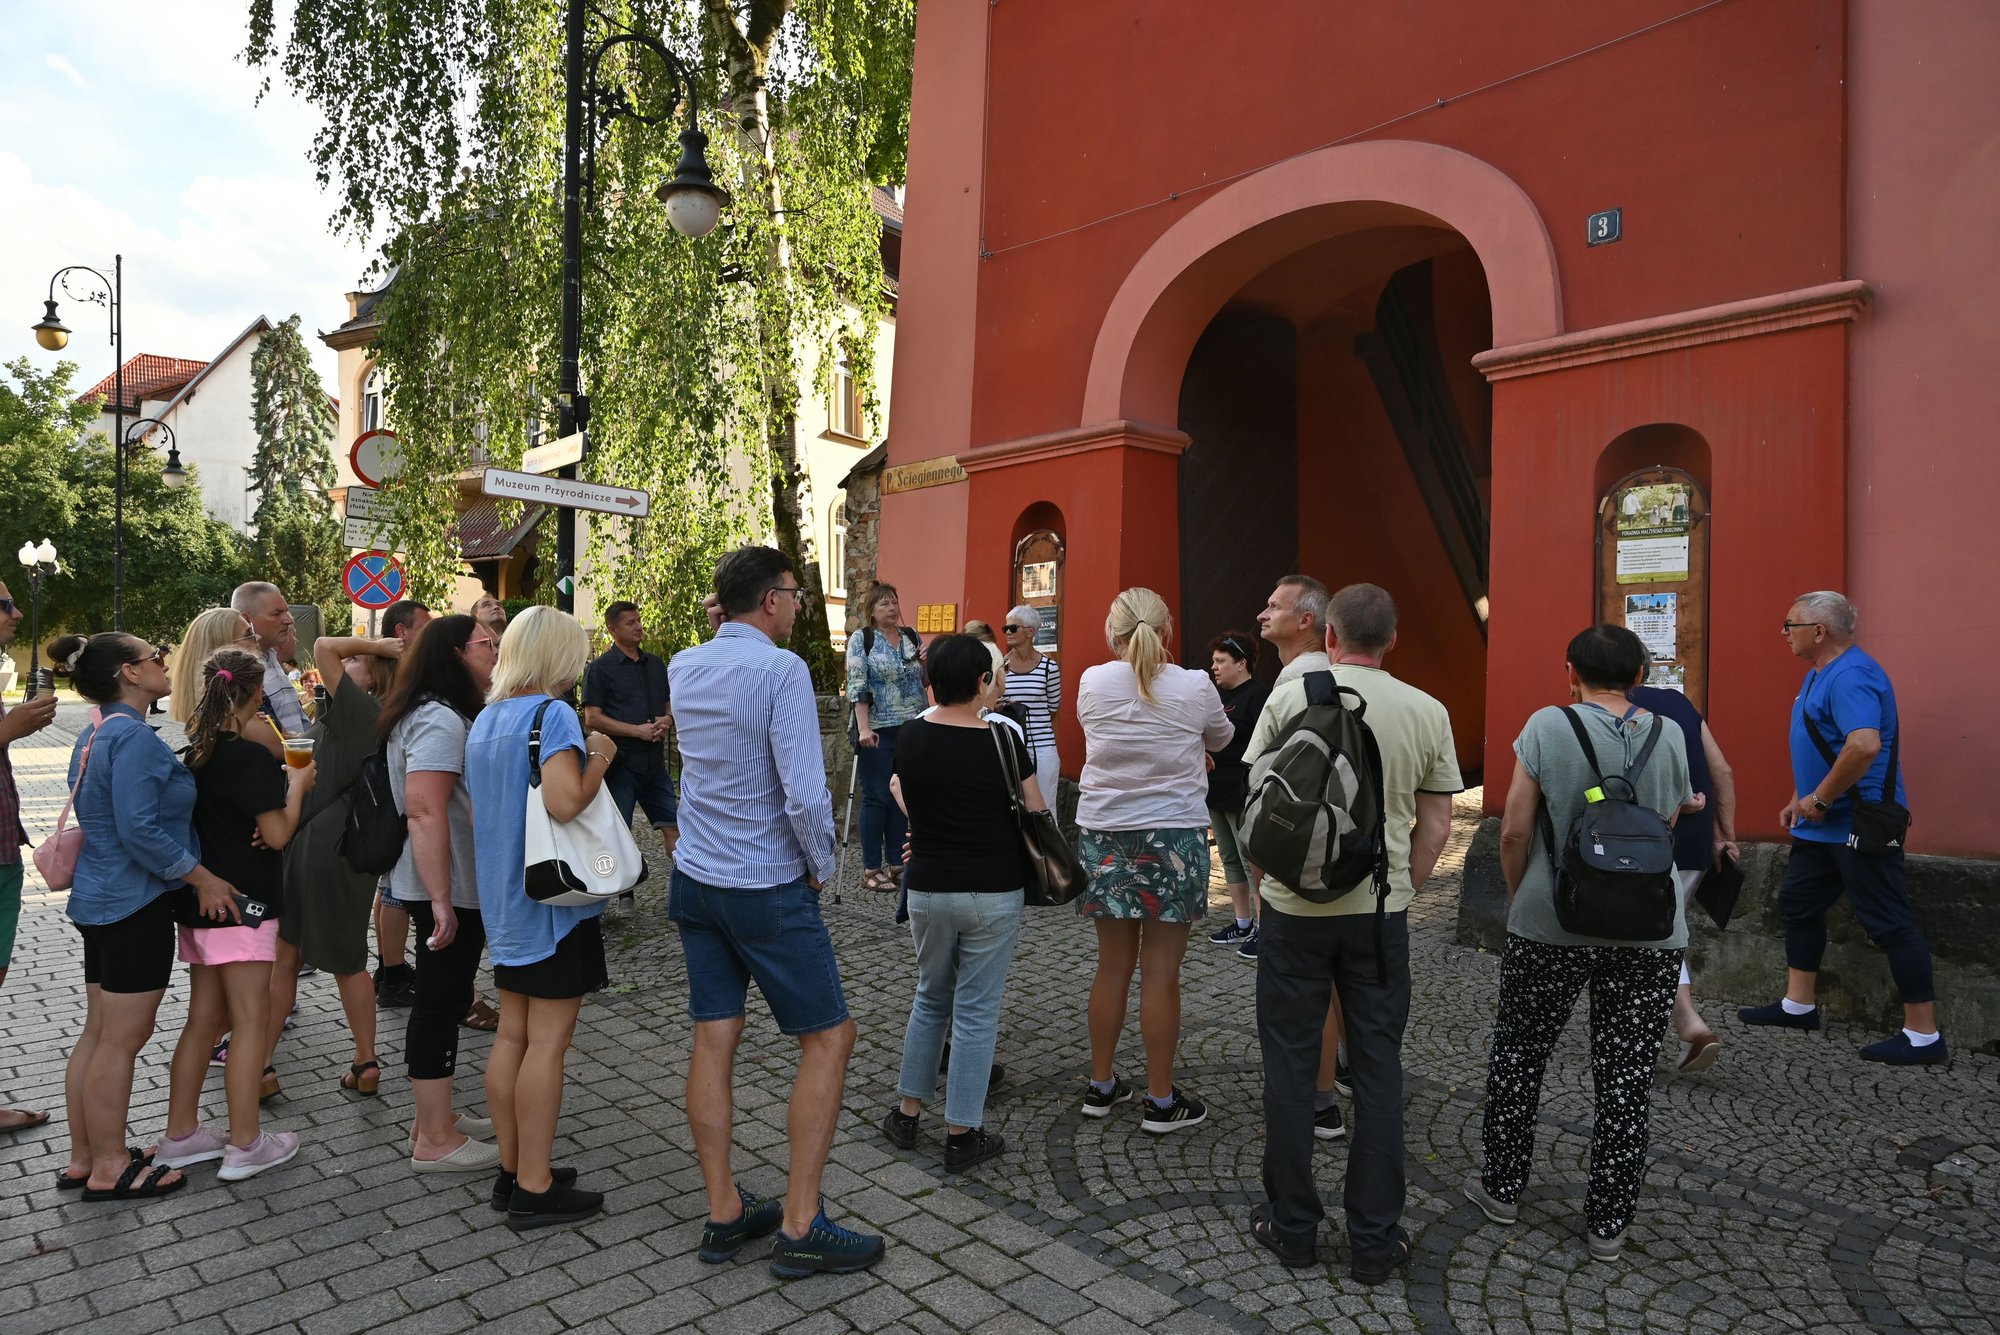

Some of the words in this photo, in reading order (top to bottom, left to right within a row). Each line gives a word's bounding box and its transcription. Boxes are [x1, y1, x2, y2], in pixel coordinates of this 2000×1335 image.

[1598, 217, 1608, 237] 3
[897, 466, 963, 487] Ściegiennego
[494, 476, 540, 492] Muzeum
[544, 484, 612, 503] Przyrodnicze
